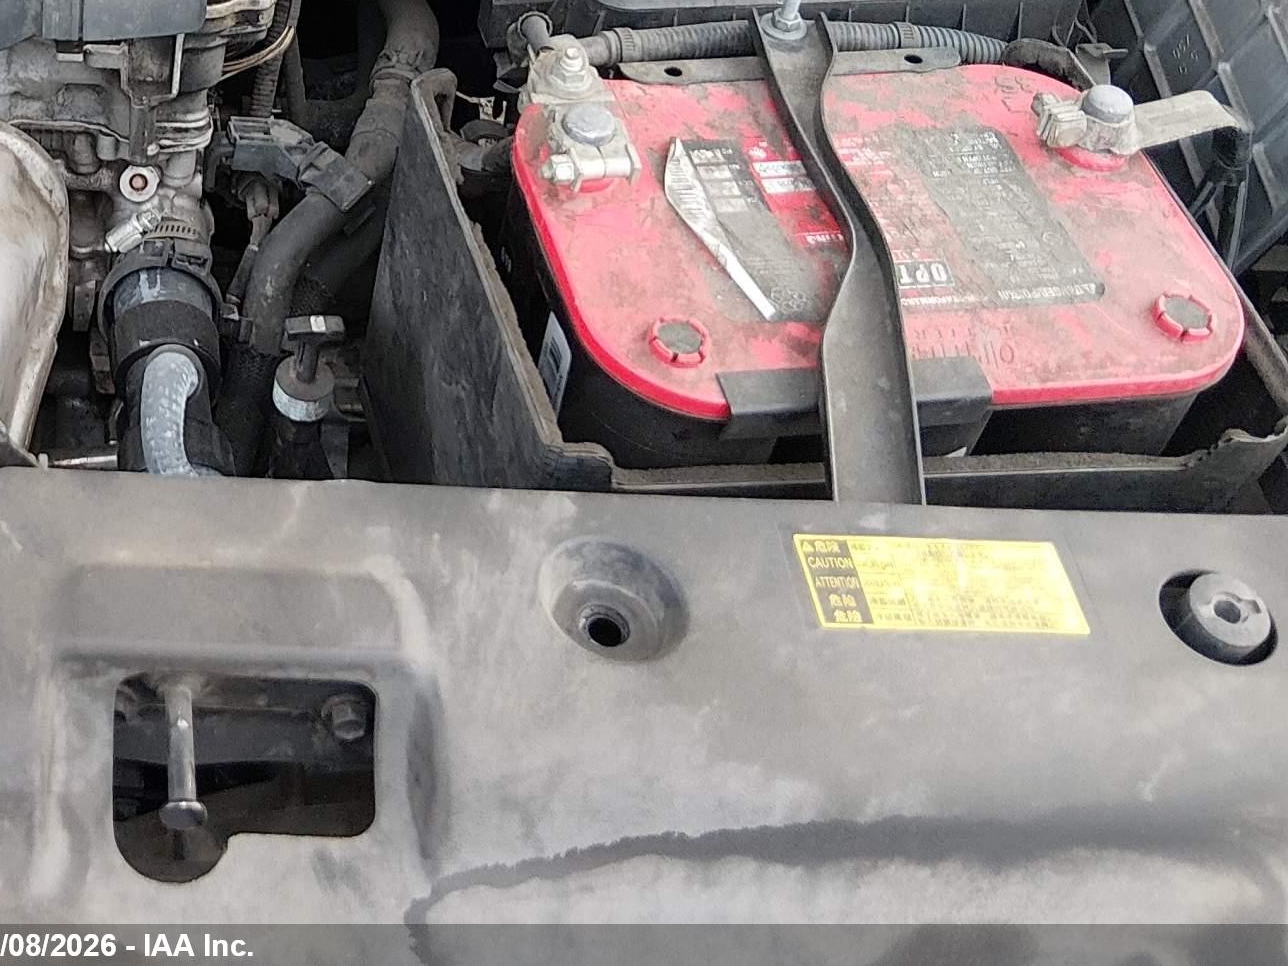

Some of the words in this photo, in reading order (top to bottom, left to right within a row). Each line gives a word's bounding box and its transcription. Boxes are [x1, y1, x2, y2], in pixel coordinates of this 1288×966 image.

[898, 262, 948, 284] OPT
[808, 556, 854, 570] CAUTION
[815, 575, 861, 589] ATTENTION
